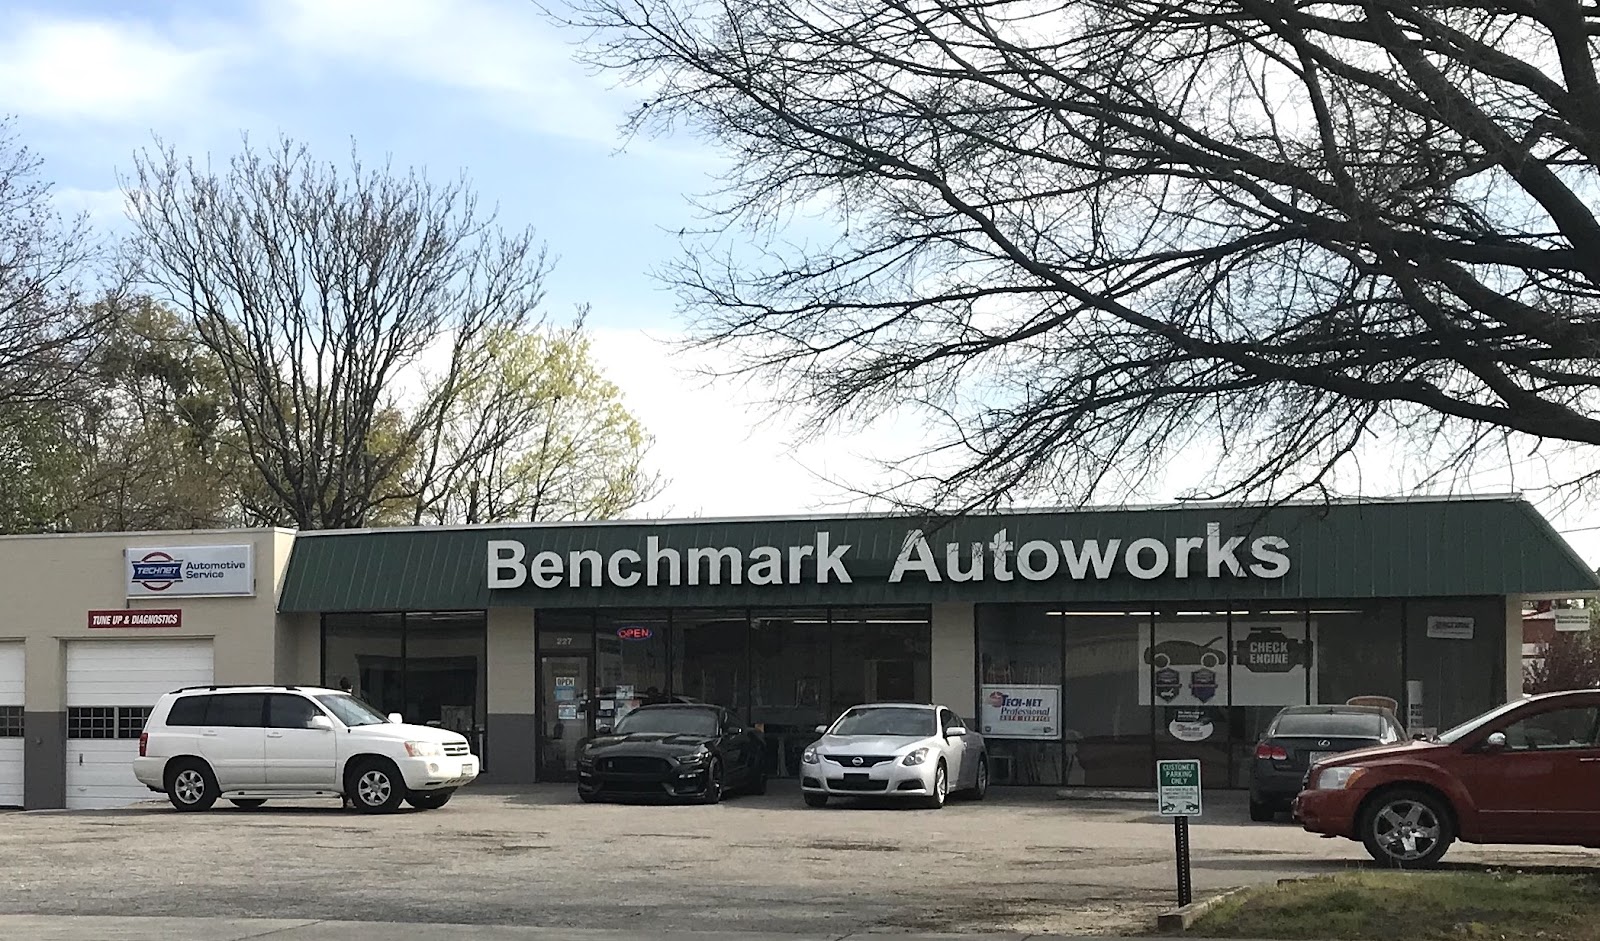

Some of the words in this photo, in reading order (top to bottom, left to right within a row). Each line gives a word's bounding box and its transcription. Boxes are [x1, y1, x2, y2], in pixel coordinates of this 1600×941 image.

[487, 532, 853, 589] Benchmark
[888, 522, 1292, 582] Autoworks
[186, 561, 246, 570] Automotive
[186, 570, 224, 579] Service
[93, 615, 111, 625] TUNE
[112, 615, 123, 625] UP
[123, 615, 130, 625] &
[131, 614, 178, 625] DIAGNOSTICS
[618, 628, 649, 639] OPEN
[556, 637, 573, 645] 227
[1250, 641, 1288, 653] CHECK
[1250, 653, 1289, 664] ENGINE
[557, 678, 574, 686] OPEN
[1001, 707, 1050, 715] Professional
